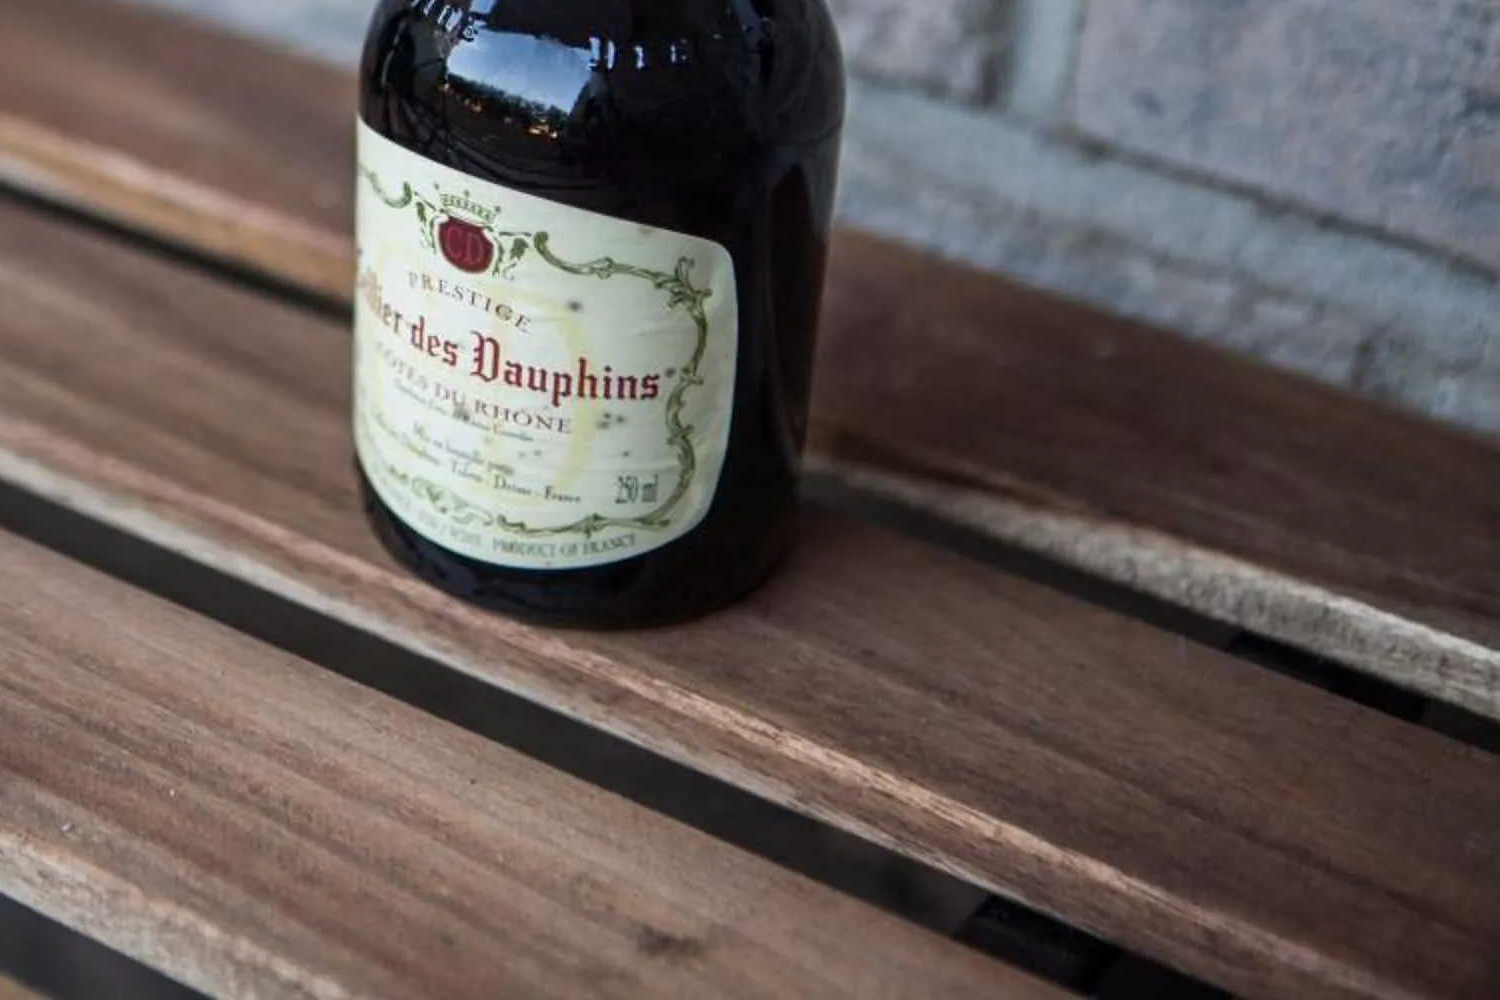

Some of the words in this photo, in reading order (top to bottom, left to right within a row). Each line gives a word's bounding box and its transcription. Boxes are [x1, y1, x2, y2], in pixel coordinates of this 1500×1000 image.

[408, 271, 532, 333] PRESTIGE
[411, 315, 459, 367] des
[469, 329, 661, 408] Dauphins
[435, 382, 466, 407] DU
